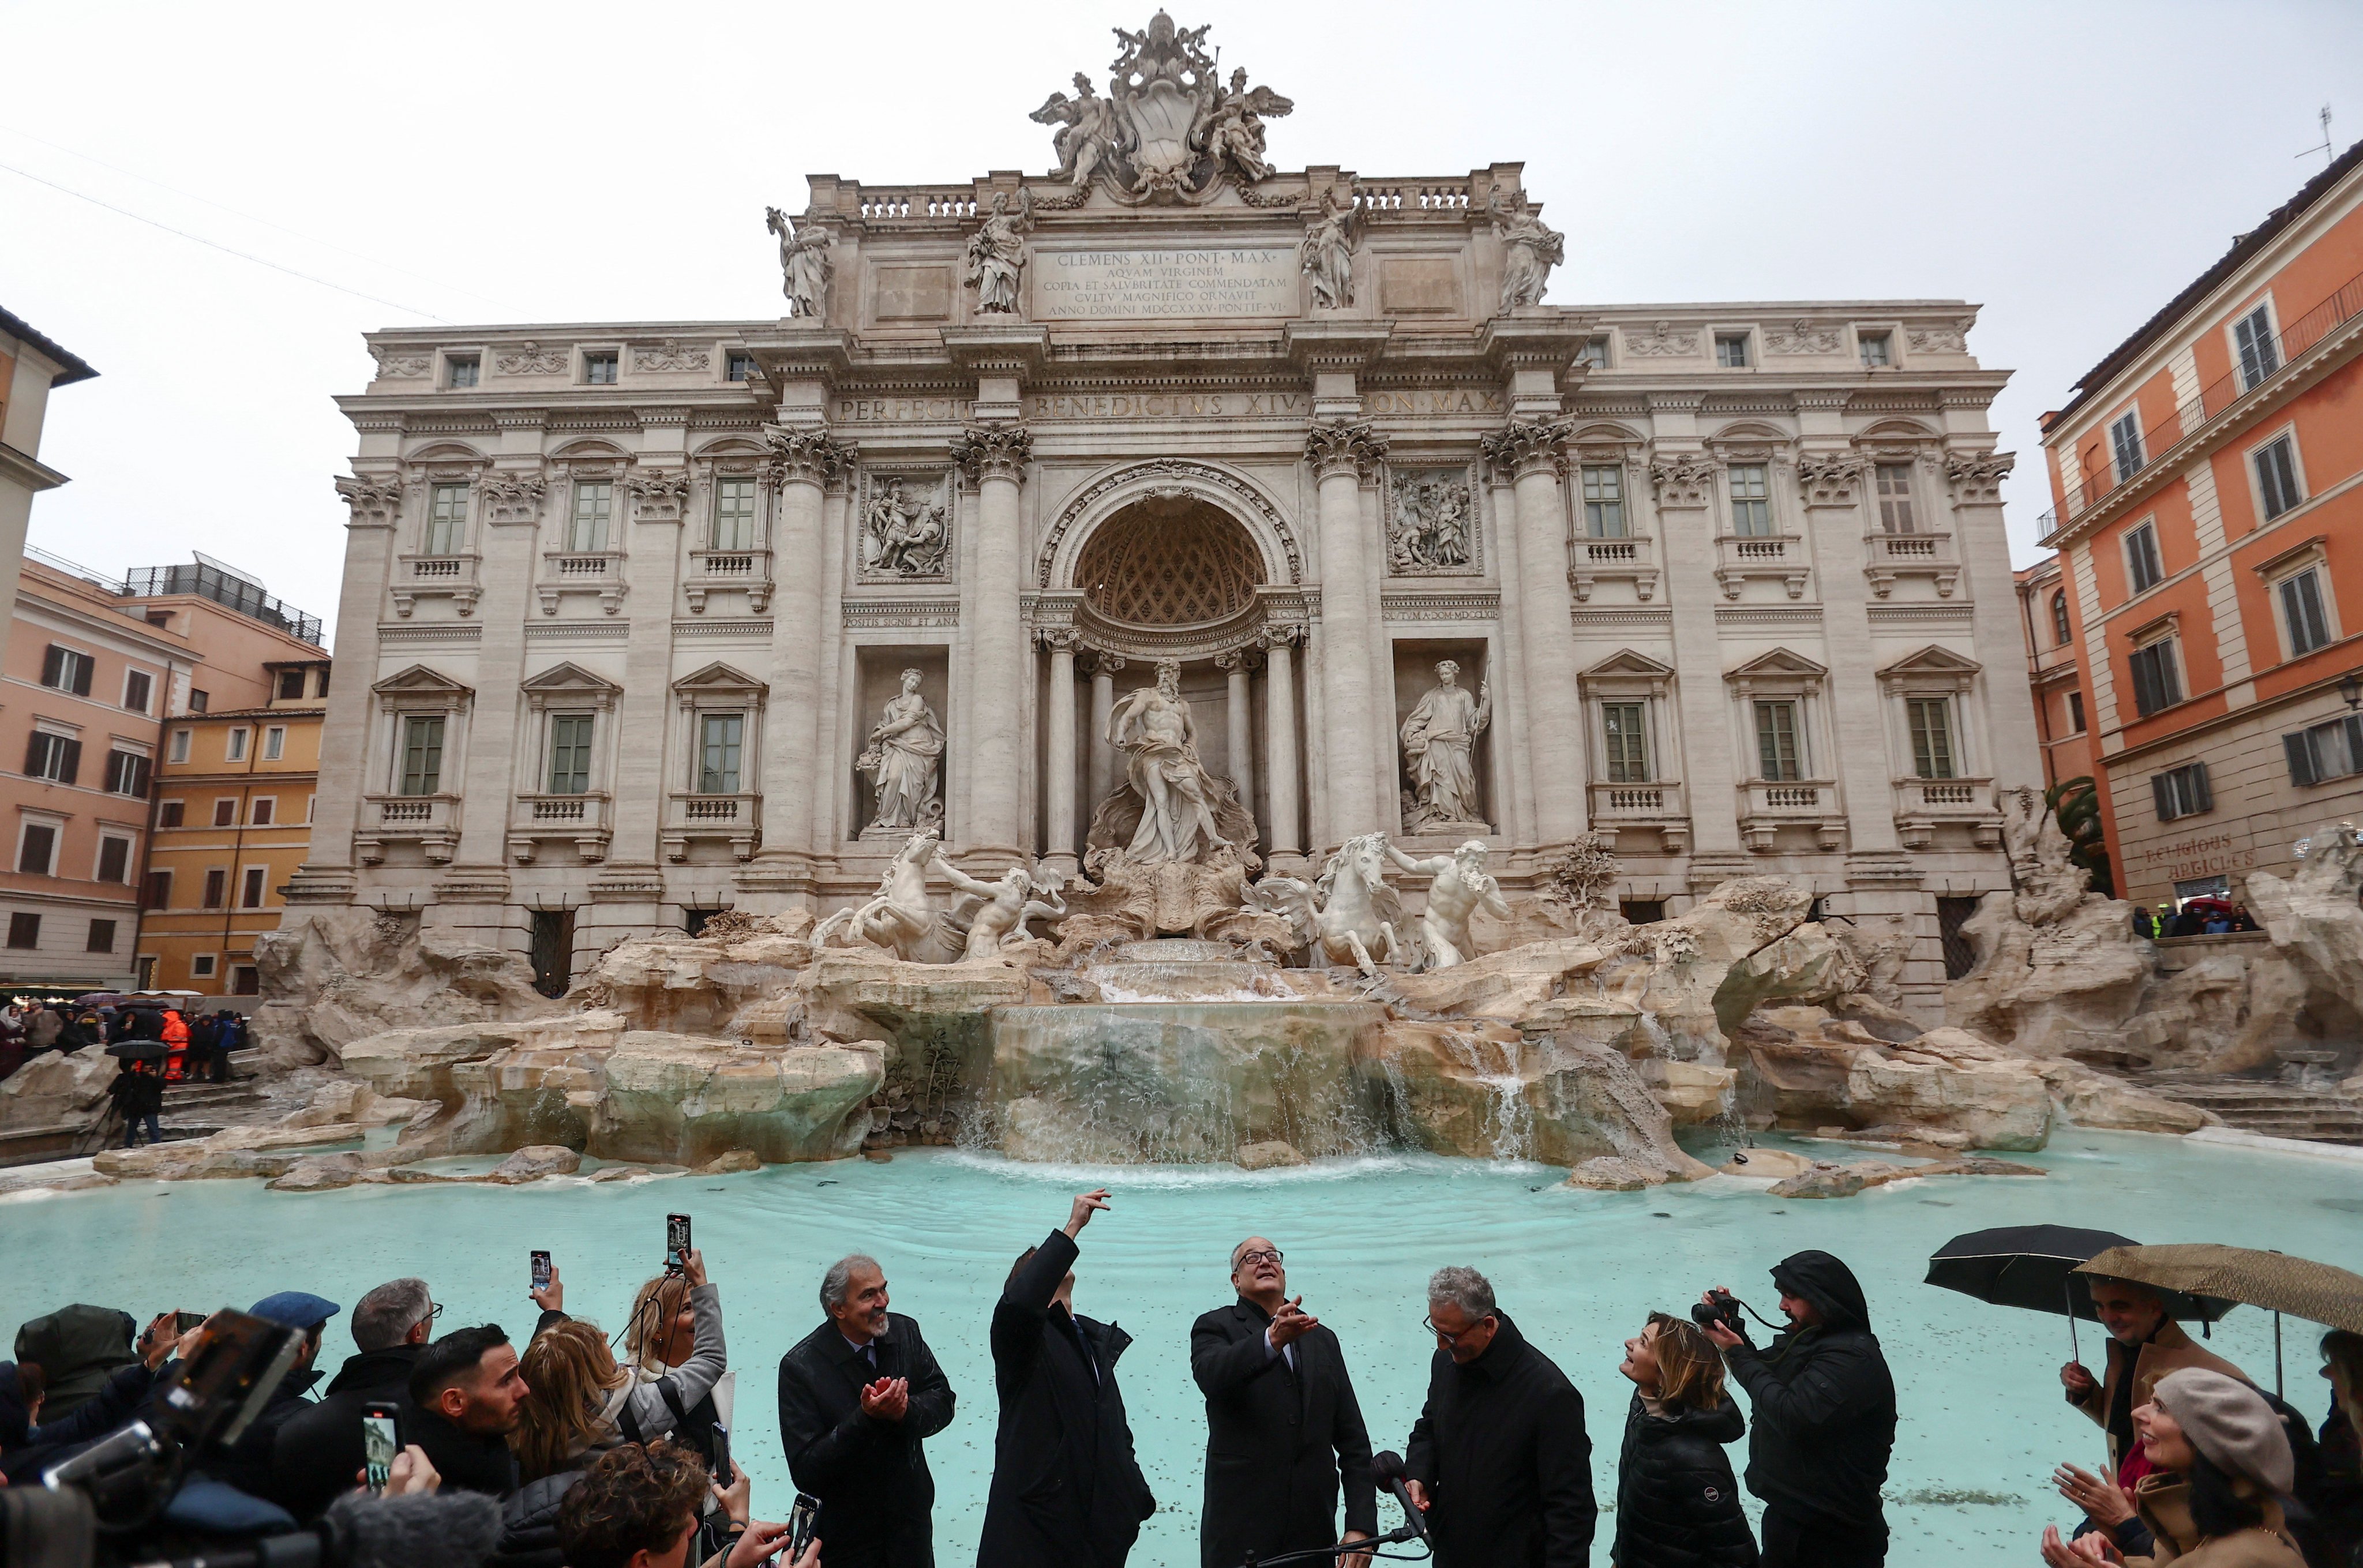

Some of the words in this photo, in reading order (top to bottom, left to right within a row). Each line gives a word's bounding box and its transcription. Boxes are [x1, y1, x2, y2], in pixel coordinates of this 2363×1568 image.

[1057, 254, 1131, 266] CLEMENS
[1107, 268, 1152, 279] AQVAM
[1161, 267, 1224, 277] VIRGINEM
[1043, 282, 1079, 291] COPIA
[1085, 281, 1098, 290] ET
[1104, 280, 1182, 290] SALVBRITATE
[1188, 279, 1286, 288] COMMENDATAM
[1075, 293, 1115, 302] CVLTV
[1123, 292, 1194, 302] MAGNIFICO
[1200, 291, 1256, 301] ORNAVIT
[1048, 306, 1085, 315] ANNO
[1090, 305, 1135, 314] DOMINI
[839, 400, 973, 421] PERFECIT
[1034, 395, 1222, 418] BENEDICTVS
[846, 618, 879, 627] POSITIS
[883, 618, 912, 626] SIGNIS
[936, 617, 958, 625] ANA
